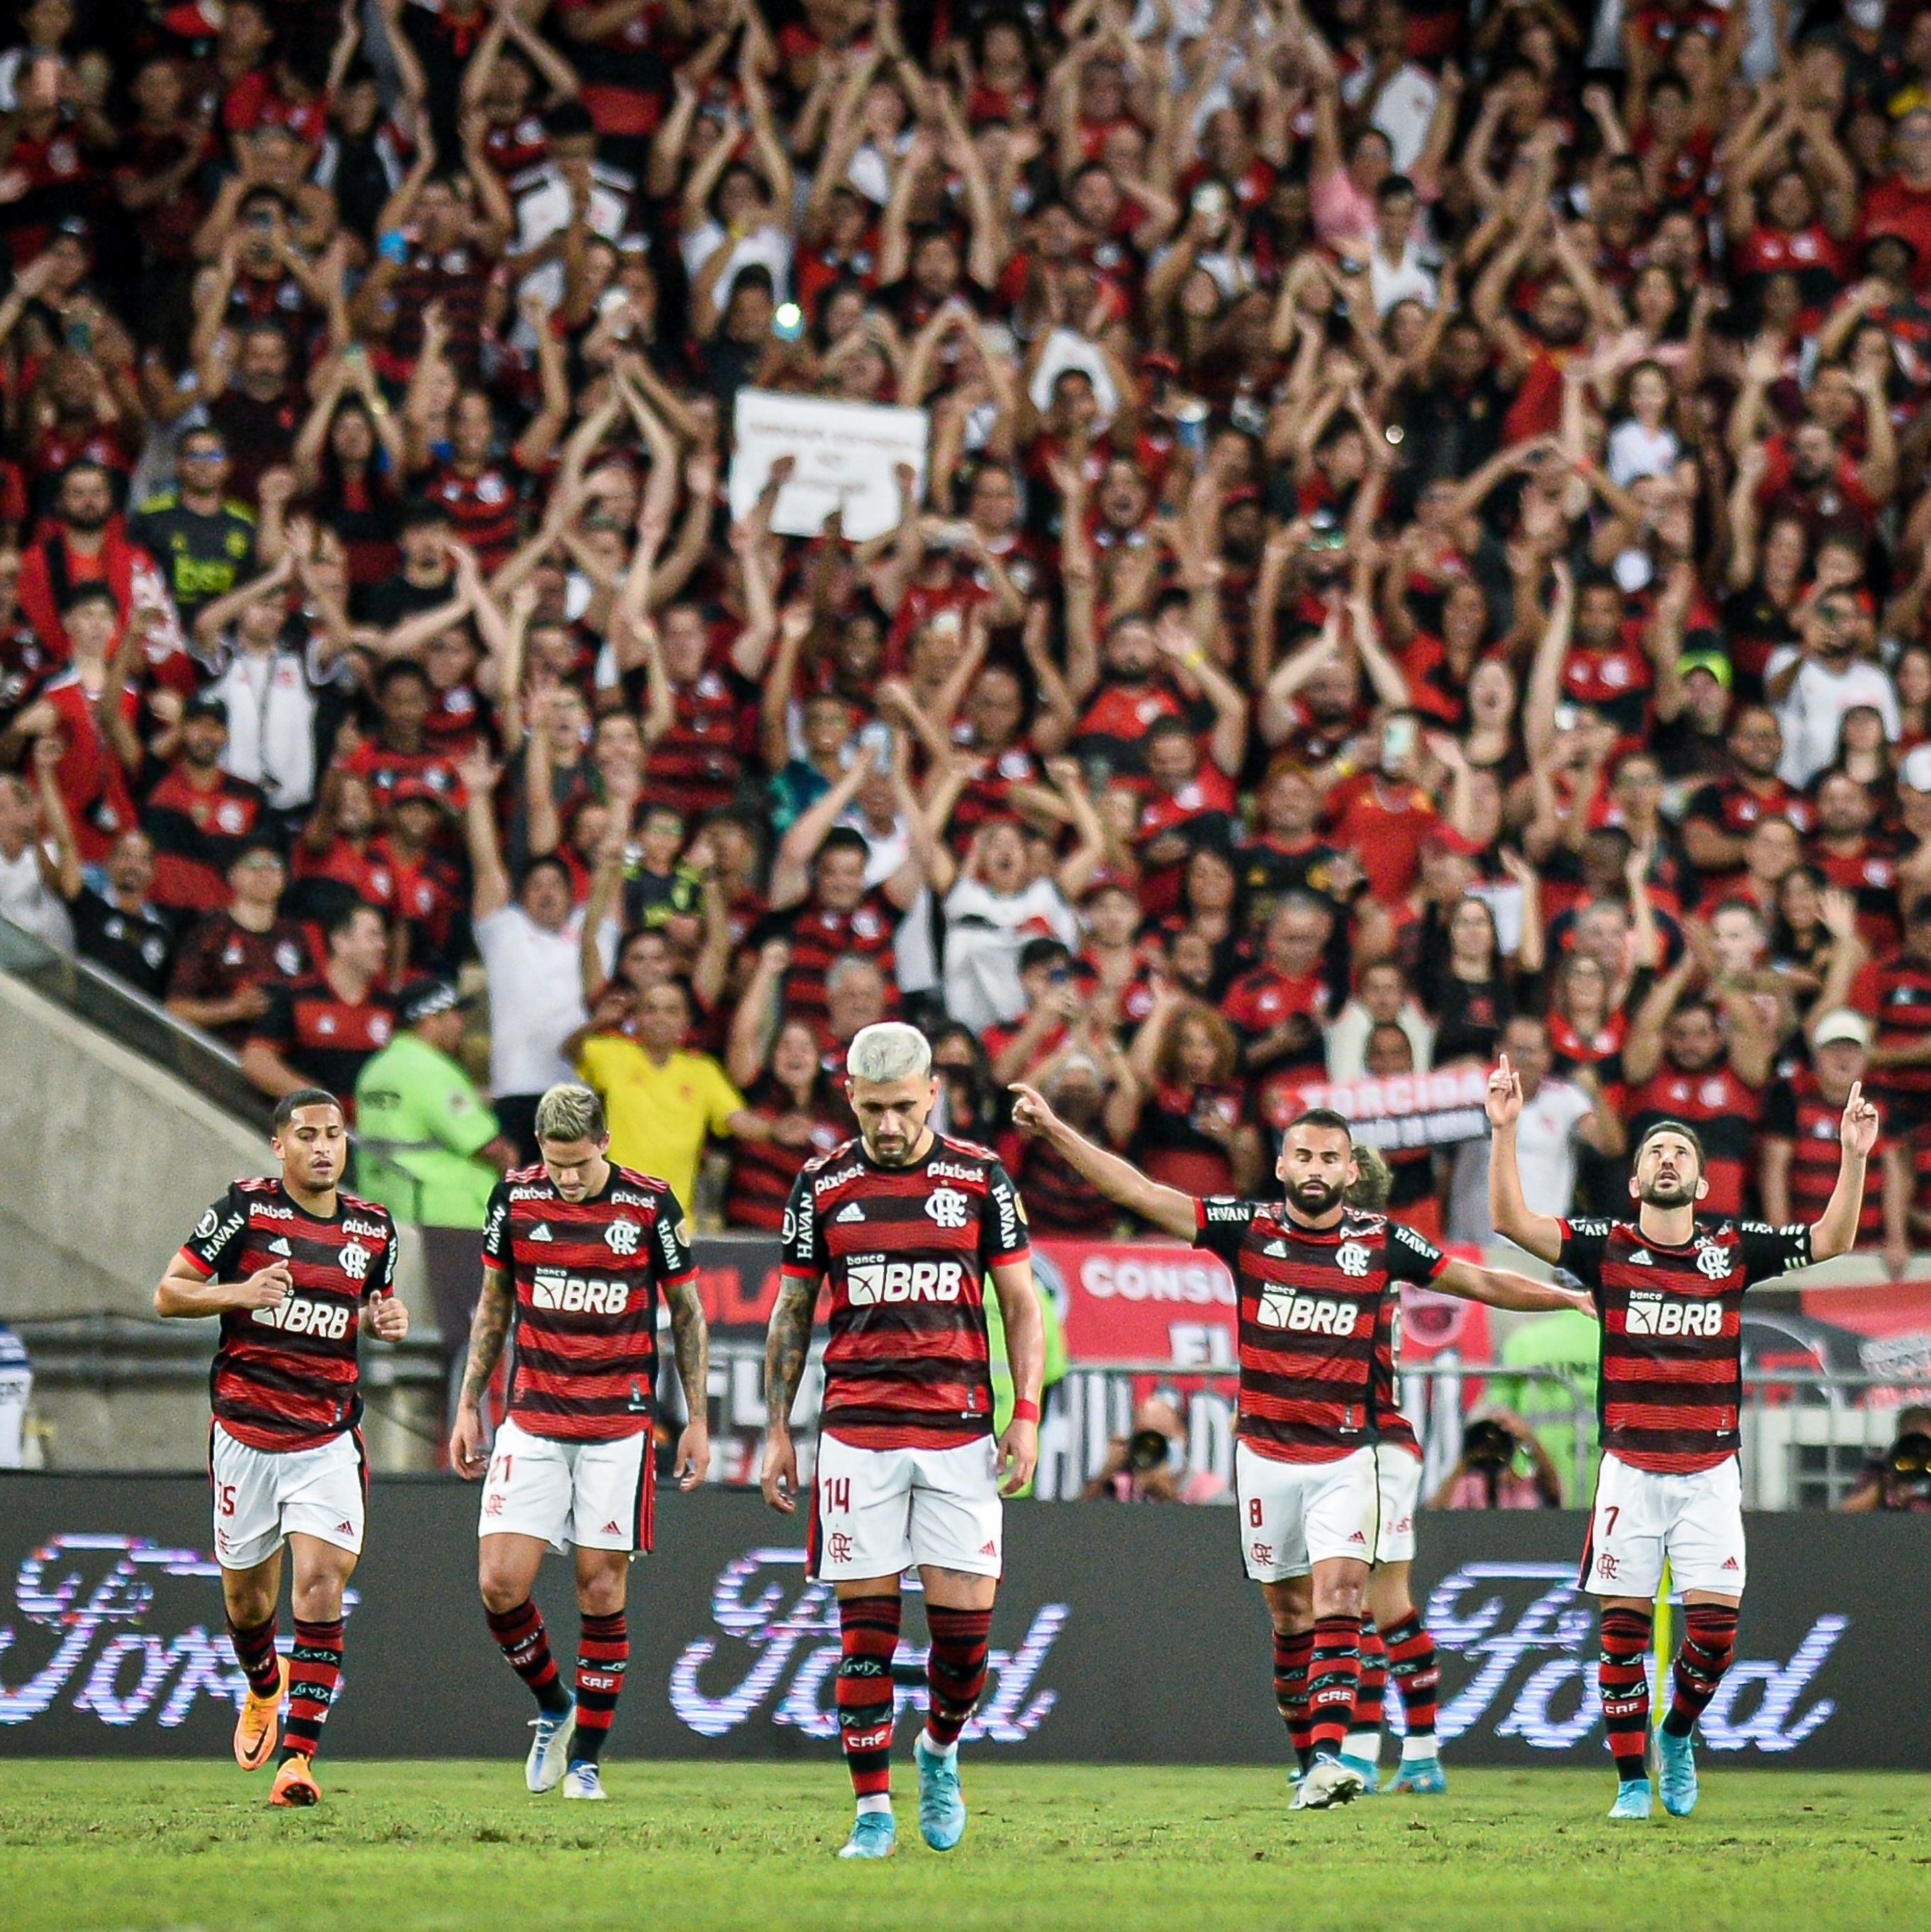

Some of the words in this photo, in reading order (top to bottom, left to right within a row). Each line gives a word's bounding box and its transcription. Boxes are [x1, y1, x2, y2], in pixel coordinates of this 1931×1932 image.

[816, 1163, 865, 1195] pixbet
[927, 1162, 985, 1183] pixbet
[509, 1187, 554, 1202] pixbet
[611, 1192, 656, 1210] pixbet
[250, 1202, 293, 1220] pixbet
[797, 1192, 814, 1259] HAVAN
[992, 1183, 1015, 1249] HAVAN
[200, 1211, 245, 1263] HAVAN
[342, 1219, 387, 1240] pixbet
[1394, 1227, 1439, 1260] HAVAN
[657, 1219, 681, 1271] HAVAN
[846, 1253, 886, 1266] banco
[536, 1266, 567, 1277] banco
[884, 1262, 963, 1302] BRB
[562, 1278, 629, 1314] BRB
[1264, 1283, 1297, 1295] banco
[1630, 1290, 1663, 1301] banco
[285, 1300, 349, 1339] BRB
[1288, 1297, 1359, 1336] BRB
[1658, 1303, 1723, 1336] BRB
[824, 1477, 851, 1514] 14
[1249, 1498, 1263, 1527] 8
[1605, 1506, 1620, 1537] 7
[1318, 1690, 1352, 1704] CRF
[1605, 1702, 1639, 1714] CRF
[847, 1730, 888, 1748] CRF
